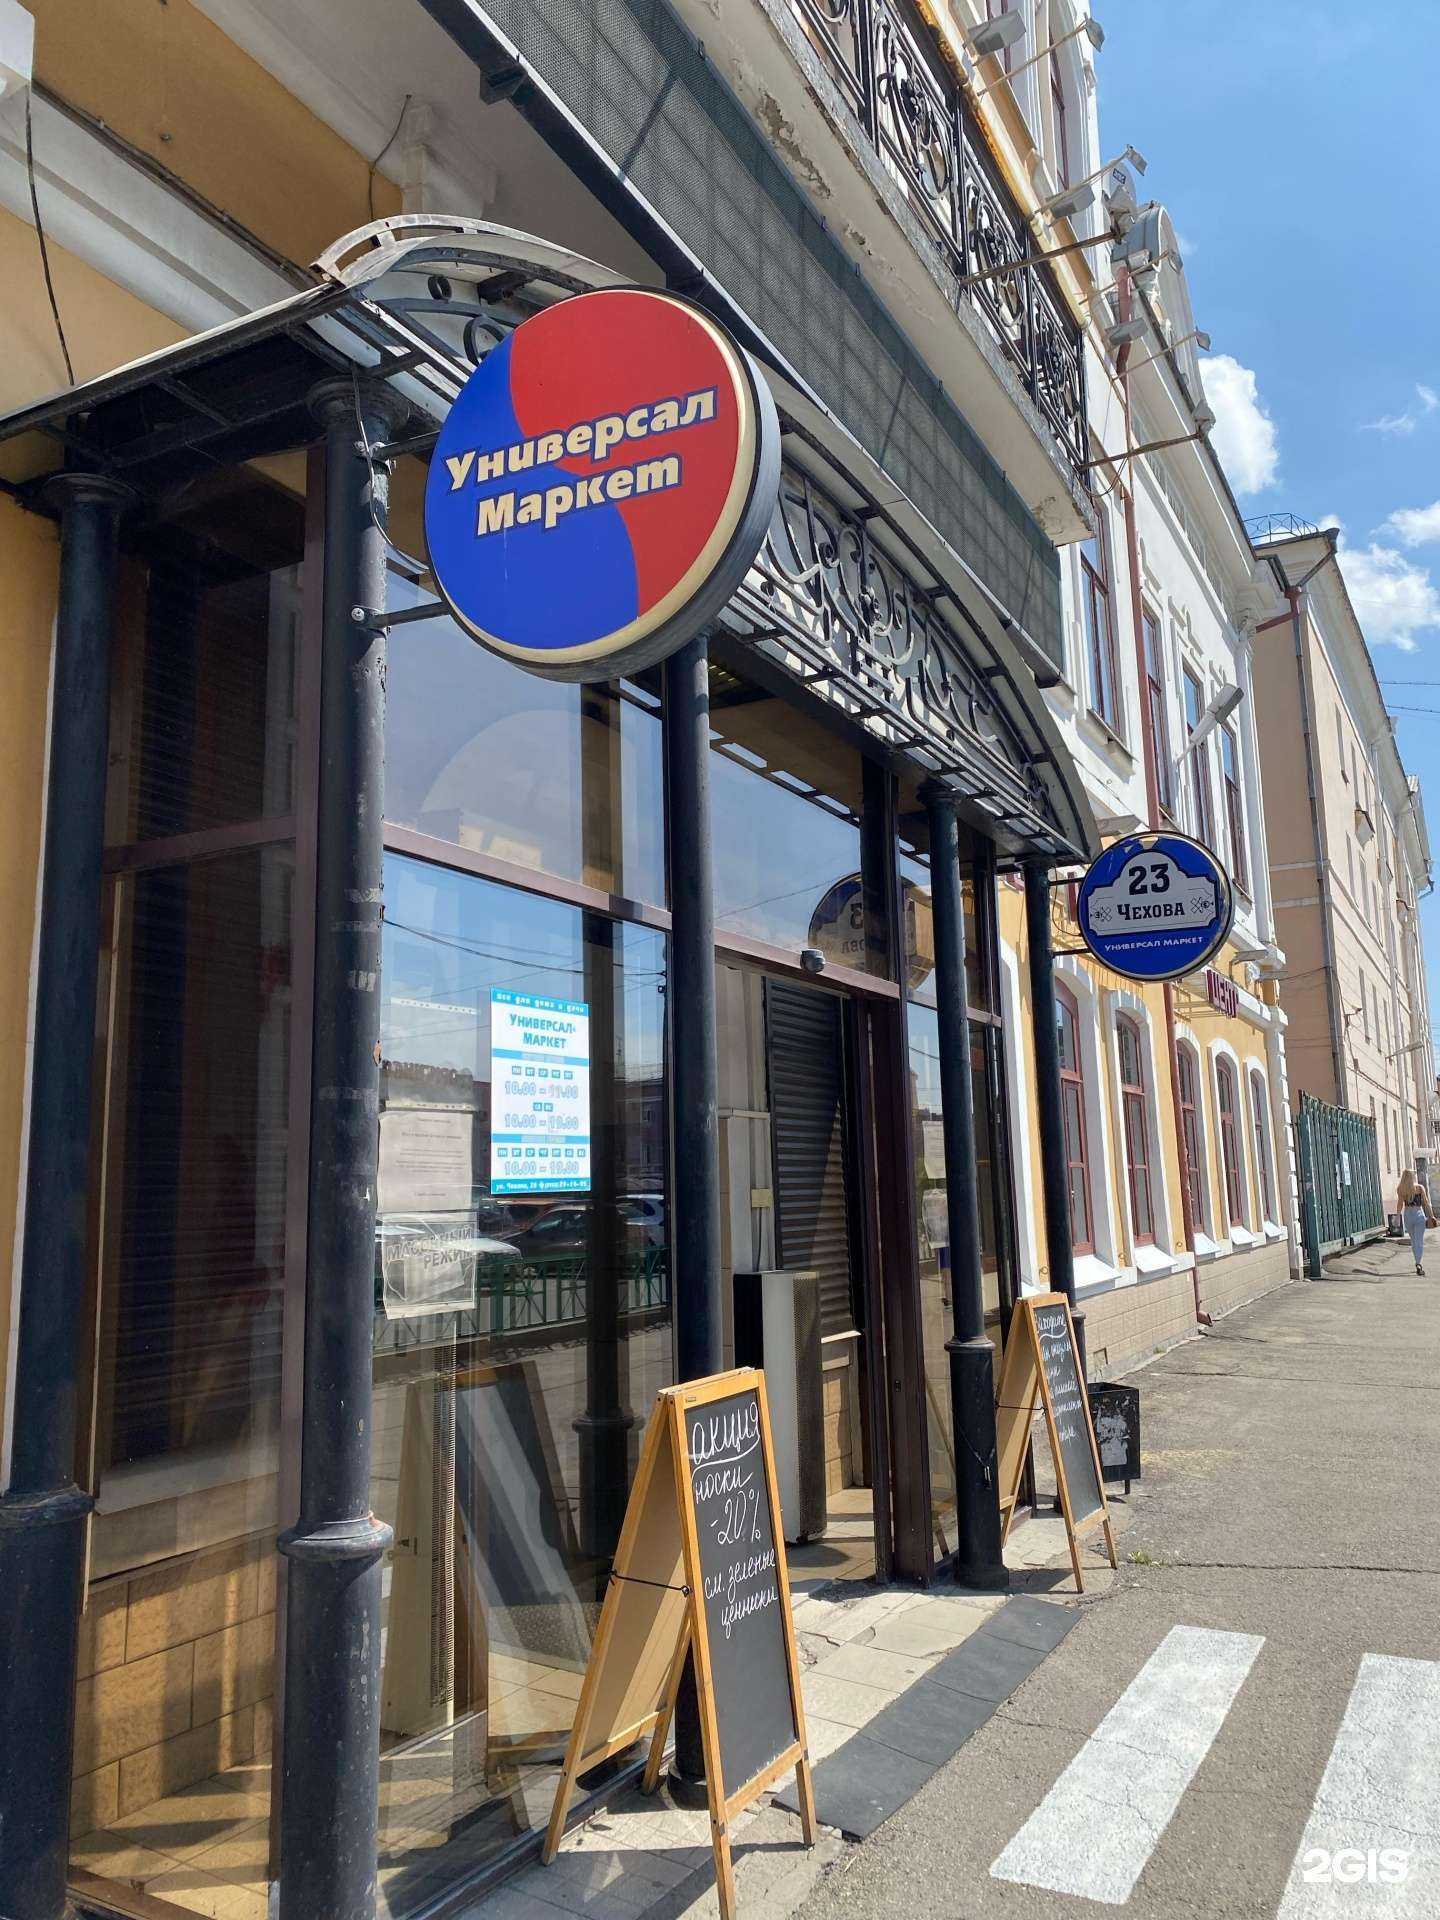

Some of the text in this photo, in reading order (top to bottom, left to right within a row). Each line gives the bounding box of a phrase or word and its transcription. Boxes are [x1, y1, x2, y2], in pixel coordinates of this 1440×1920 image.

[445, 390, 714, 491] Универсал
[477, 456, 679, 536] Маркет
[1128, 863, 1170, 896] 23
[522, 1031, 567, 1049] МАРКЕТ
[695, 1466, 754, 1505] носки
[727, 1548, 776, 1605] зеленые
